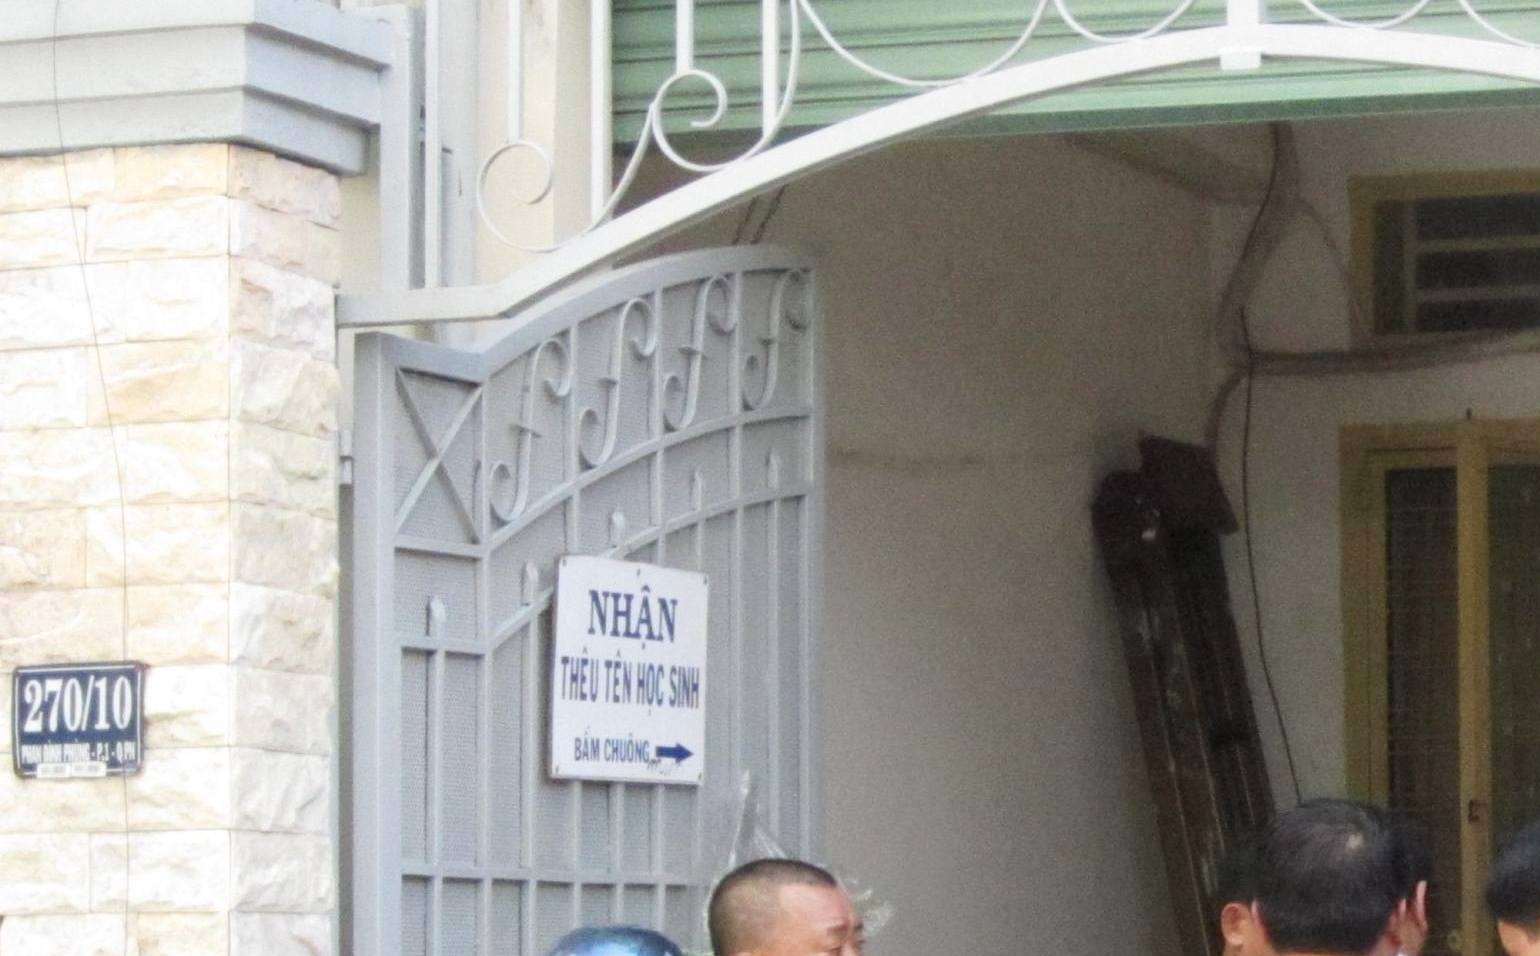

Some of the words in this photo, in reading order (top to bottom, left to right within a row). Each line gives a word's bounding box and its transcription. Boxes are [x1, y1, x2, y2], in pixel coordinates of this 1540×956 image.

[588, 584, 678, 650] NHẬN
[23, 674, 133, 732] 270/10
[561, 646, 599, 702] THÊU
[605, 649, 632, 703] TÊN
[636, 662, 664, 716] HỌC
[669, 664, 700, 709] SINH
[604, 731, 649, 763] CHUÔNG
